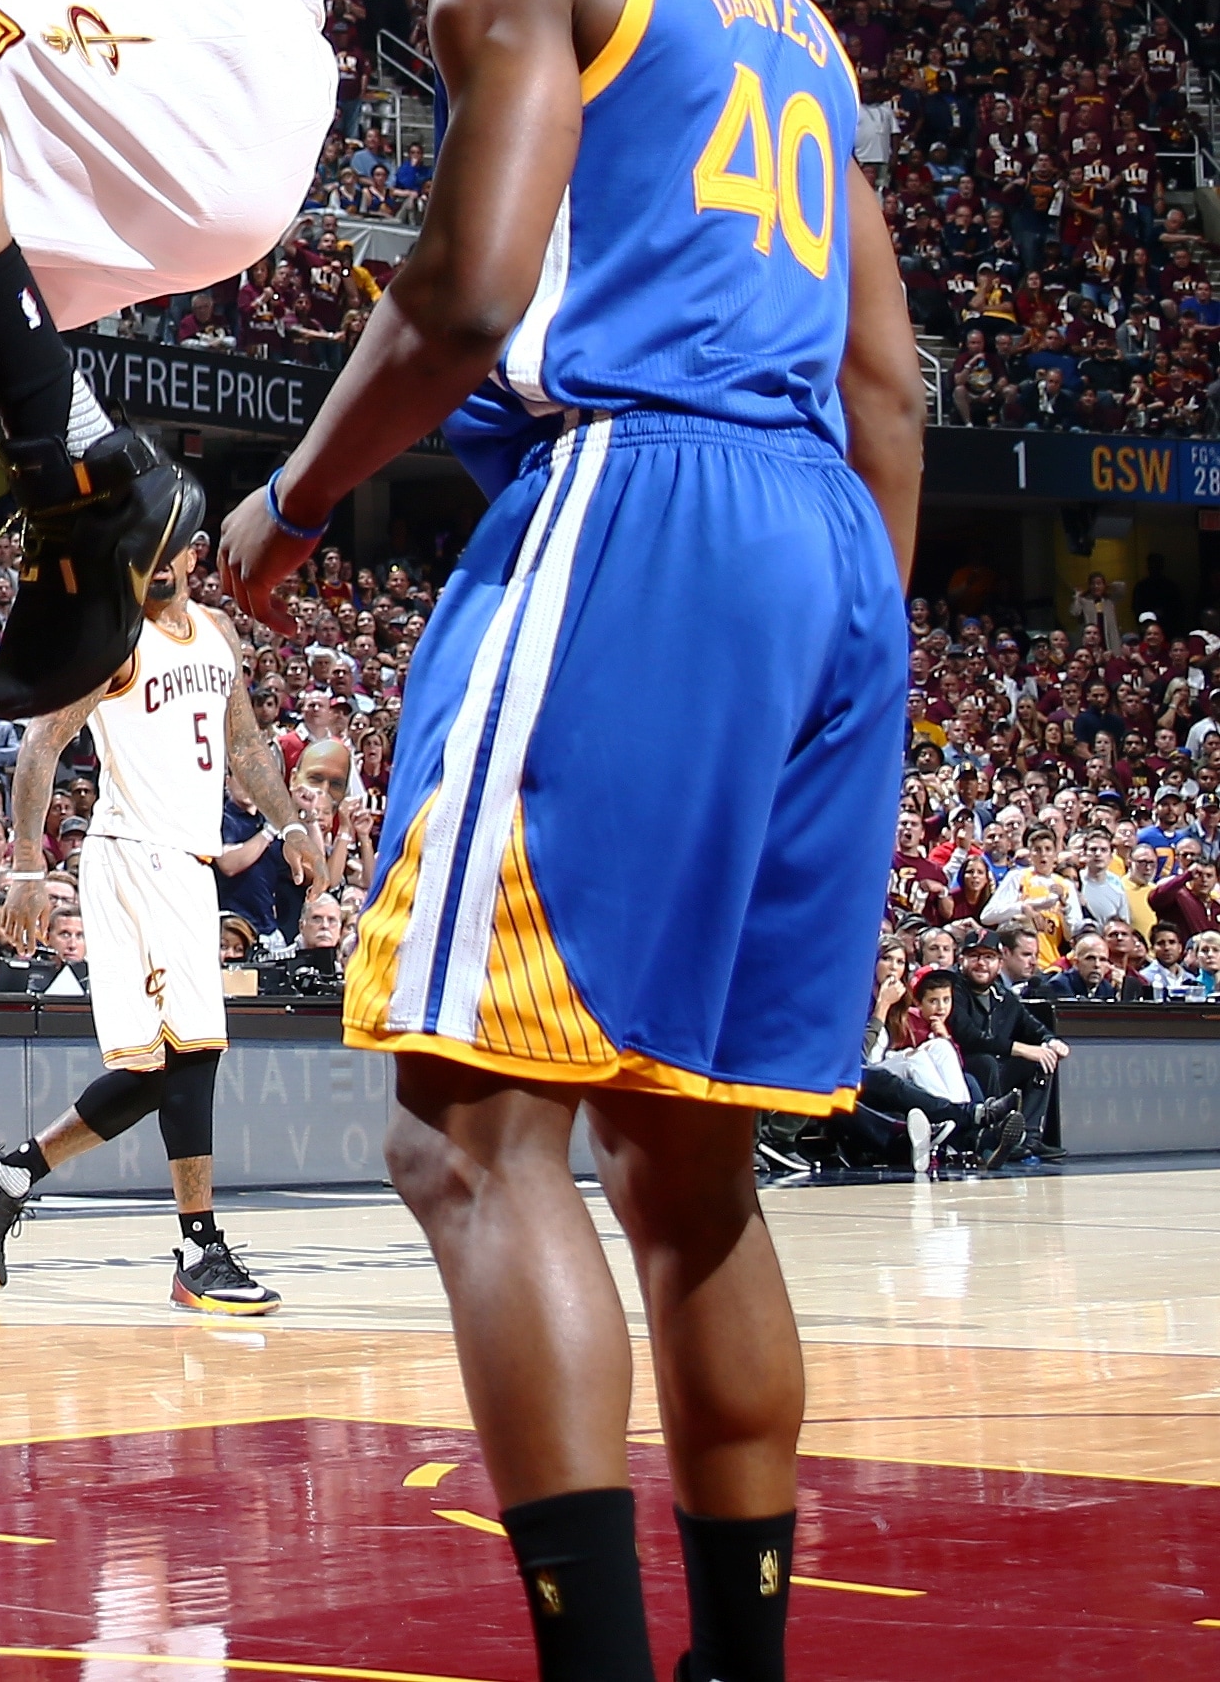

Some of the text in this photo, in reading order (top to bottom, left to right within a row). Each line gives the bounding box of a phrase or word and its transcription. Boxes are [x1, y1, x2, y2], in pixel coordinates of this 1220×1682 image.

[693, 62, 834, 280] 40
[124, 355, 211, 412] FREE
[217, 369, 304, 425] PRICE
[1013, 440, 1026, 489] 1
[1091, 445, 1171, 494] GSW
[144, 664, 231, 714] CAVALIER
[193, 712, 213, 772] 5
